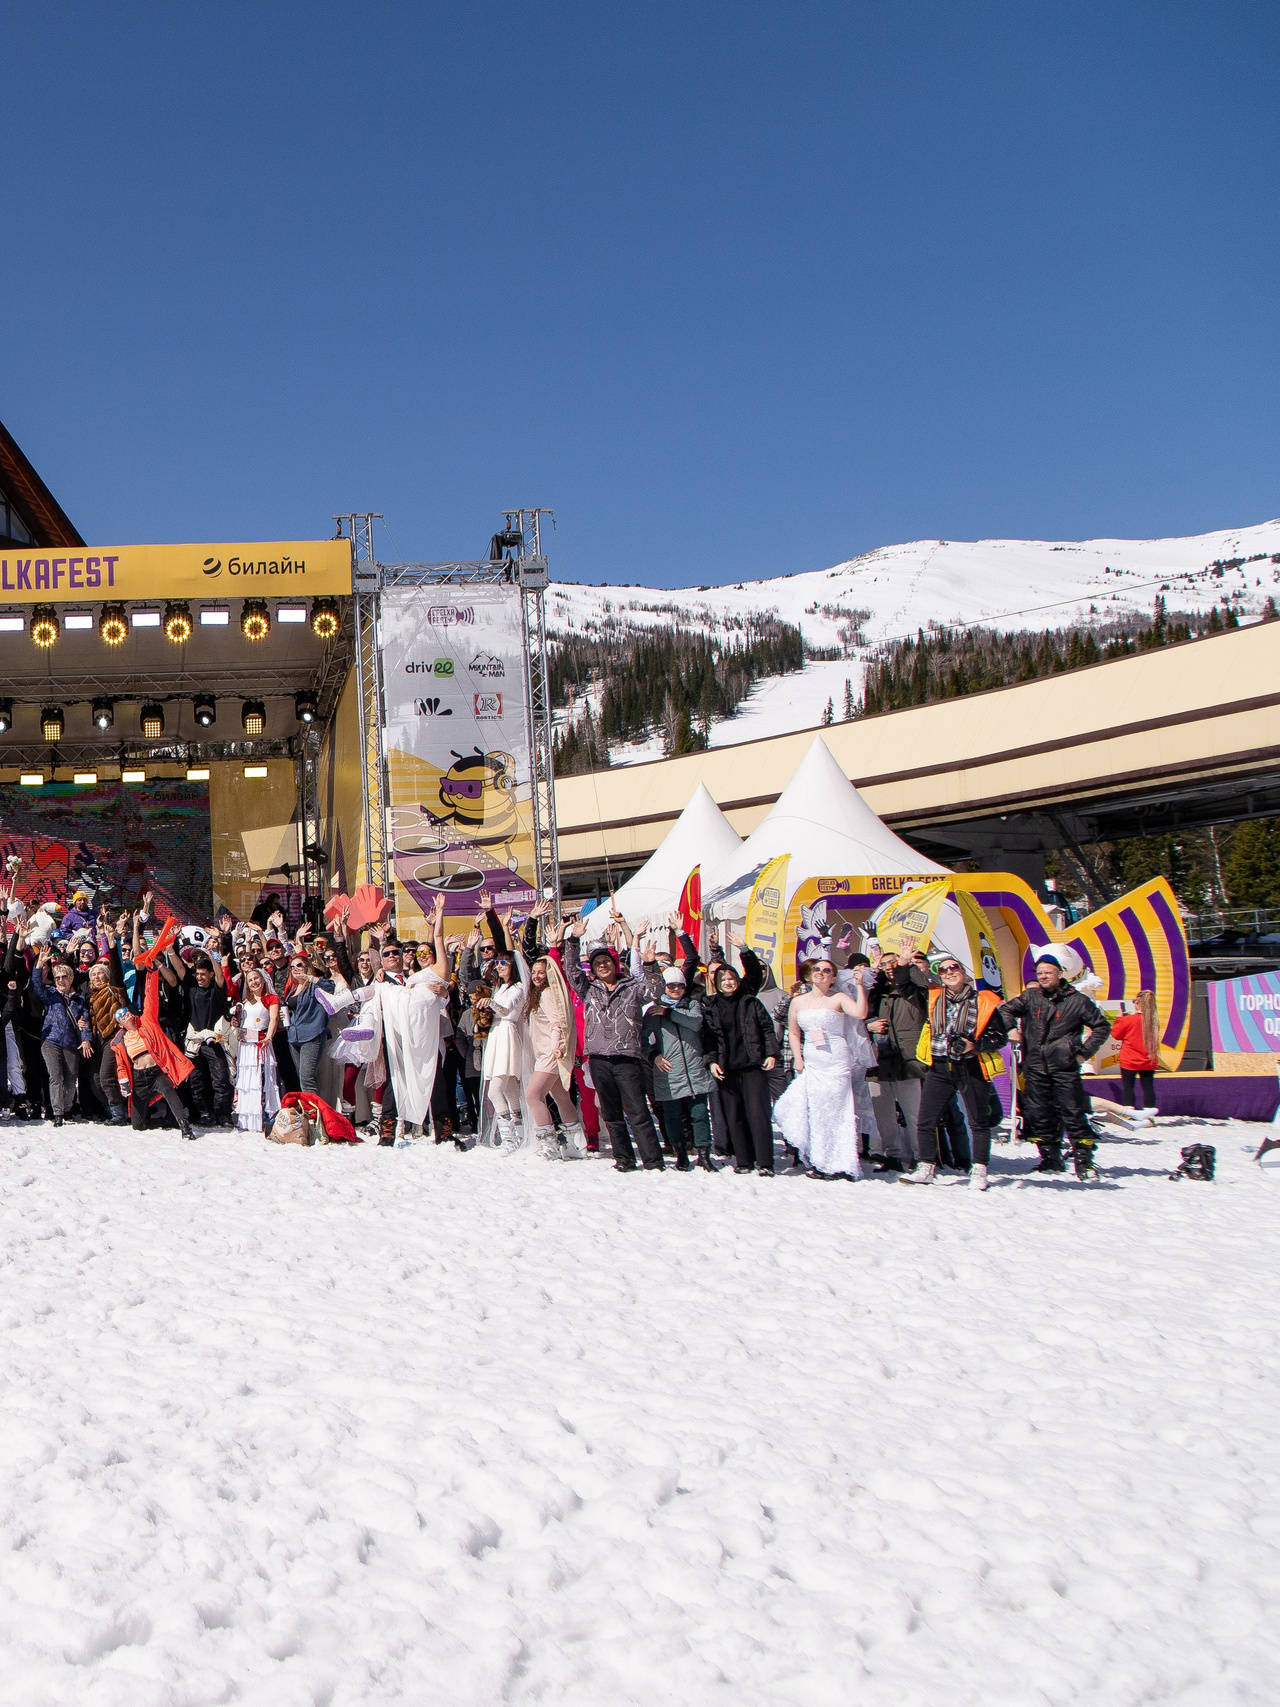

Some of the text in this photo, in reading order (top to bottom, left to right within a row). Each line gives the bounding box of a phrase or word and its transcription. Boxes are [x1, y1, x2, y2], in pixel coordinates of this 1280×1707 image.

[228, 557, 306, 576] билайн
[432, 616, 449, 624] FEST
[405, 660, 455, 674] drivee
[469, 663, 505, 672] MOUNTAIN
[153, 791, 200, 800] билайн
